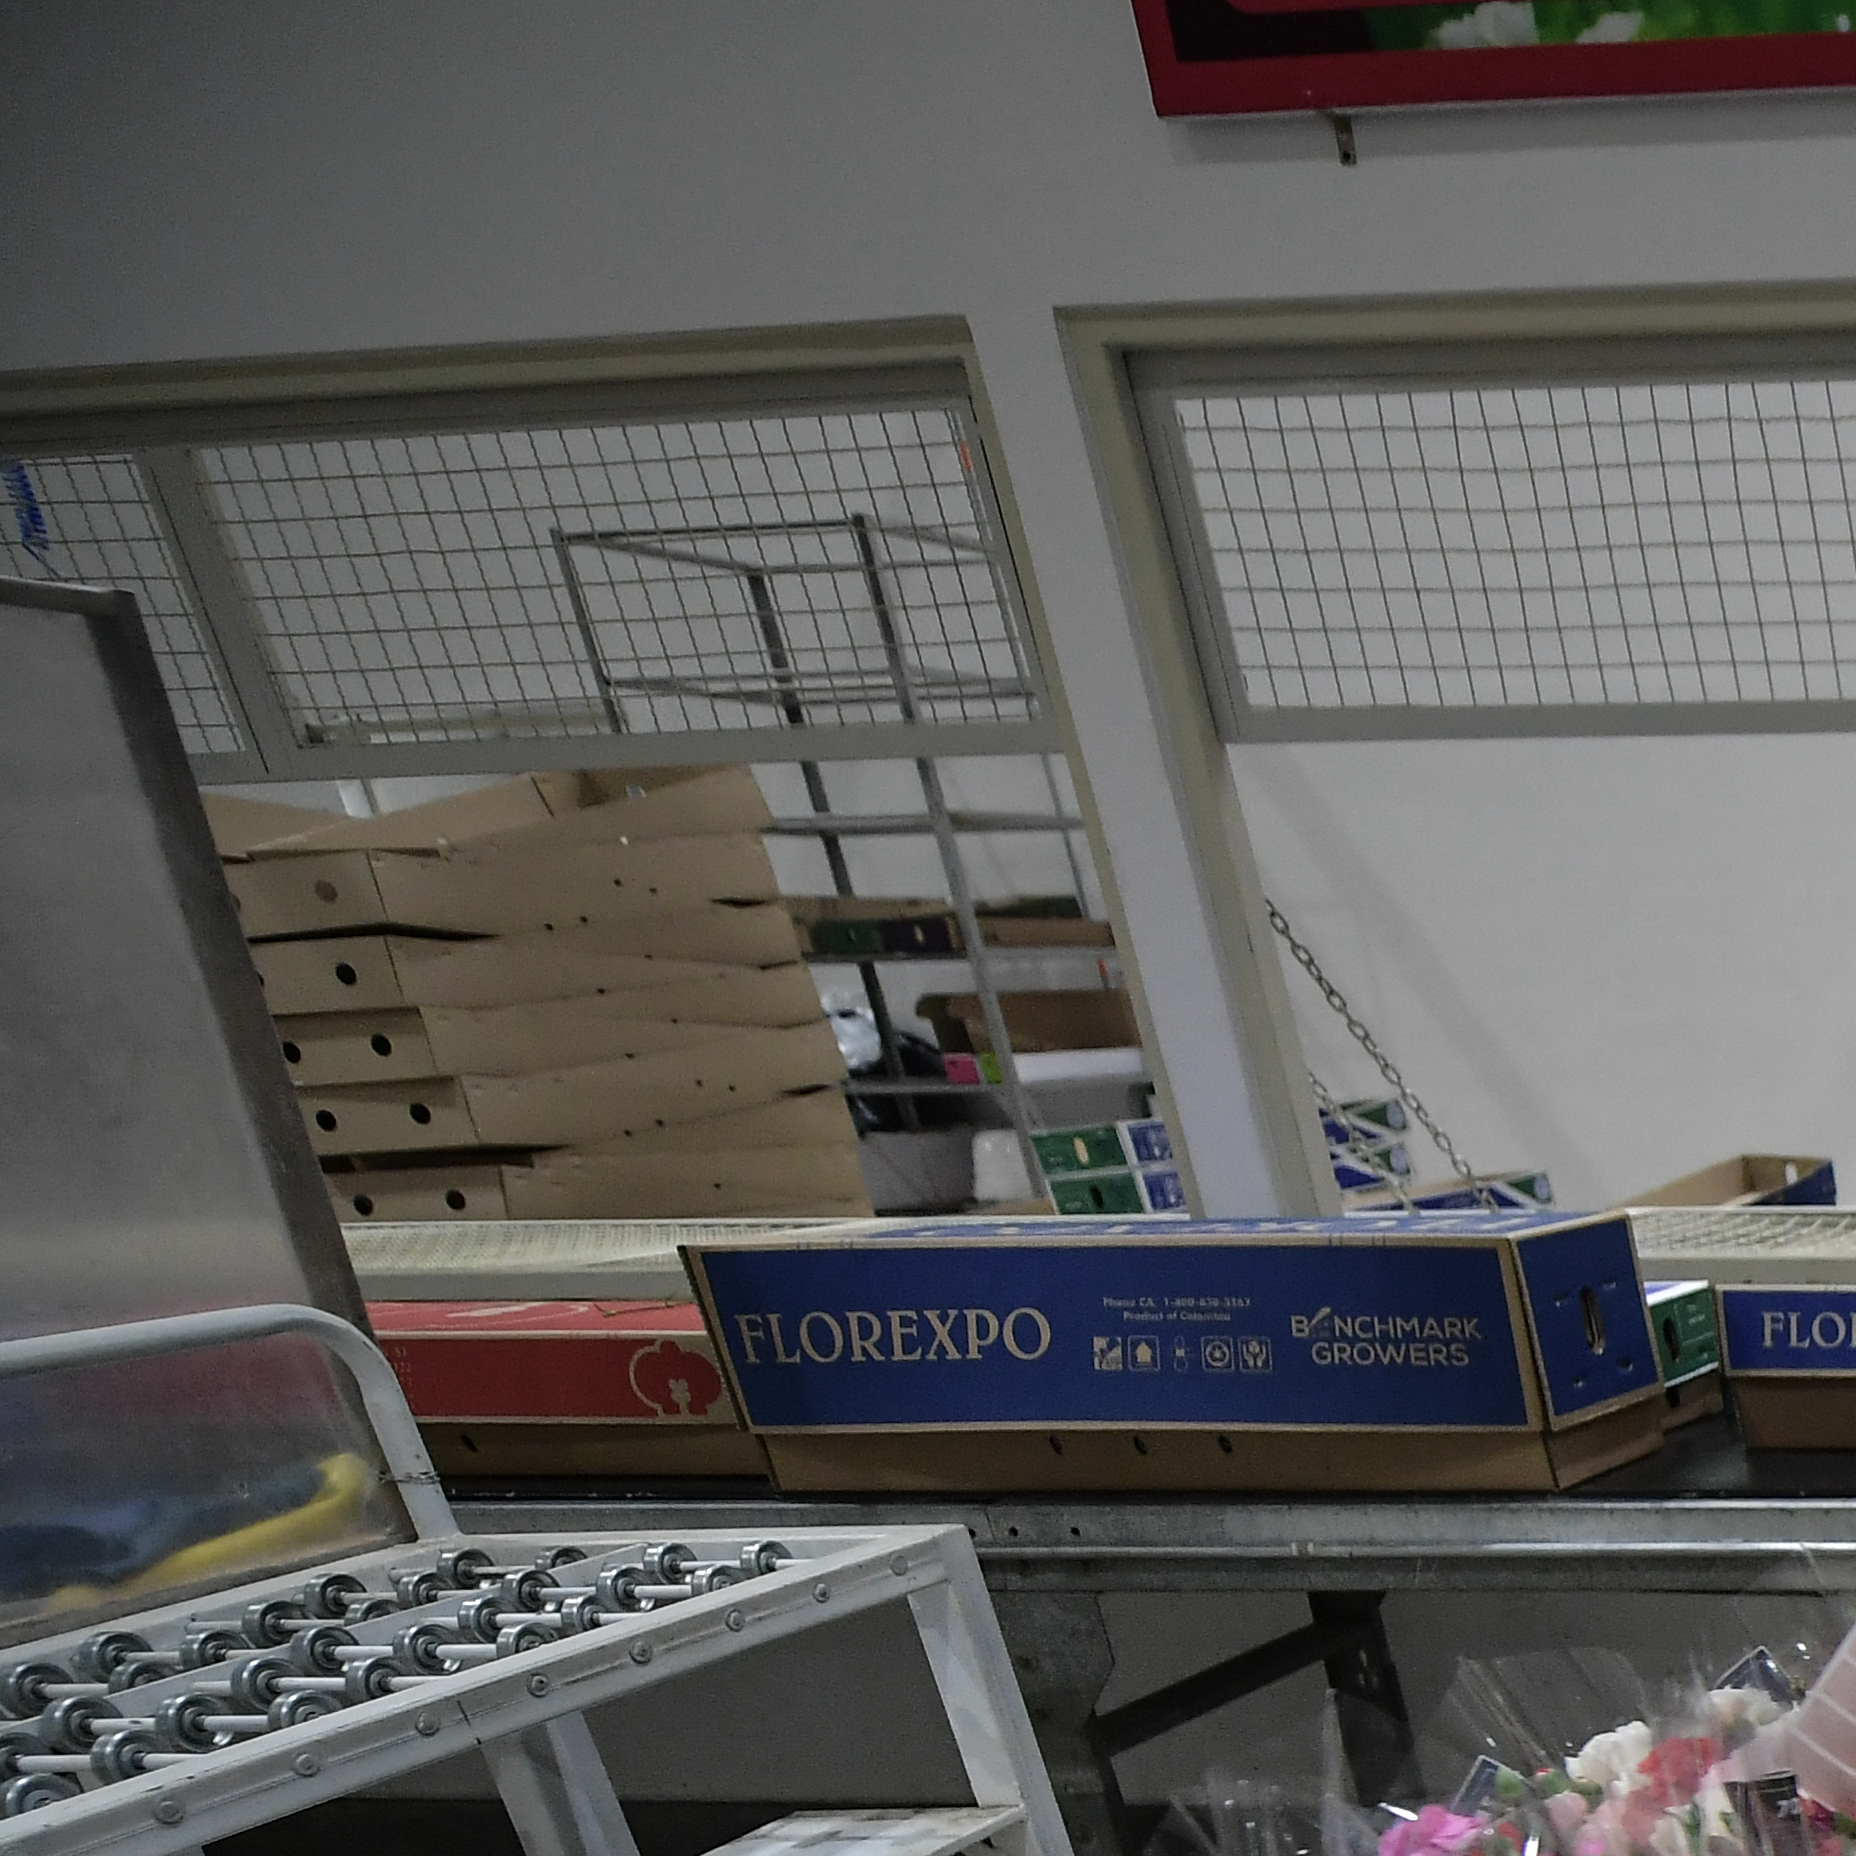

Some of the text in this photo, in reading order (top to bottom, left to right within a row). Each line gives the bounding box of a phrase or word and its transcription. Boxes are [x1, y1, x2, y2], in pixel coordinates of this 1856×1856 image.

[1123, 1311, 1231, 1322] Product of Colombia
[1291, 1307, 1482, 1340] BNCHMARK
[734, 1307, 1051, 1363] FLOREXPO
[1311, 1342, 1470, 1366] GROWERS
